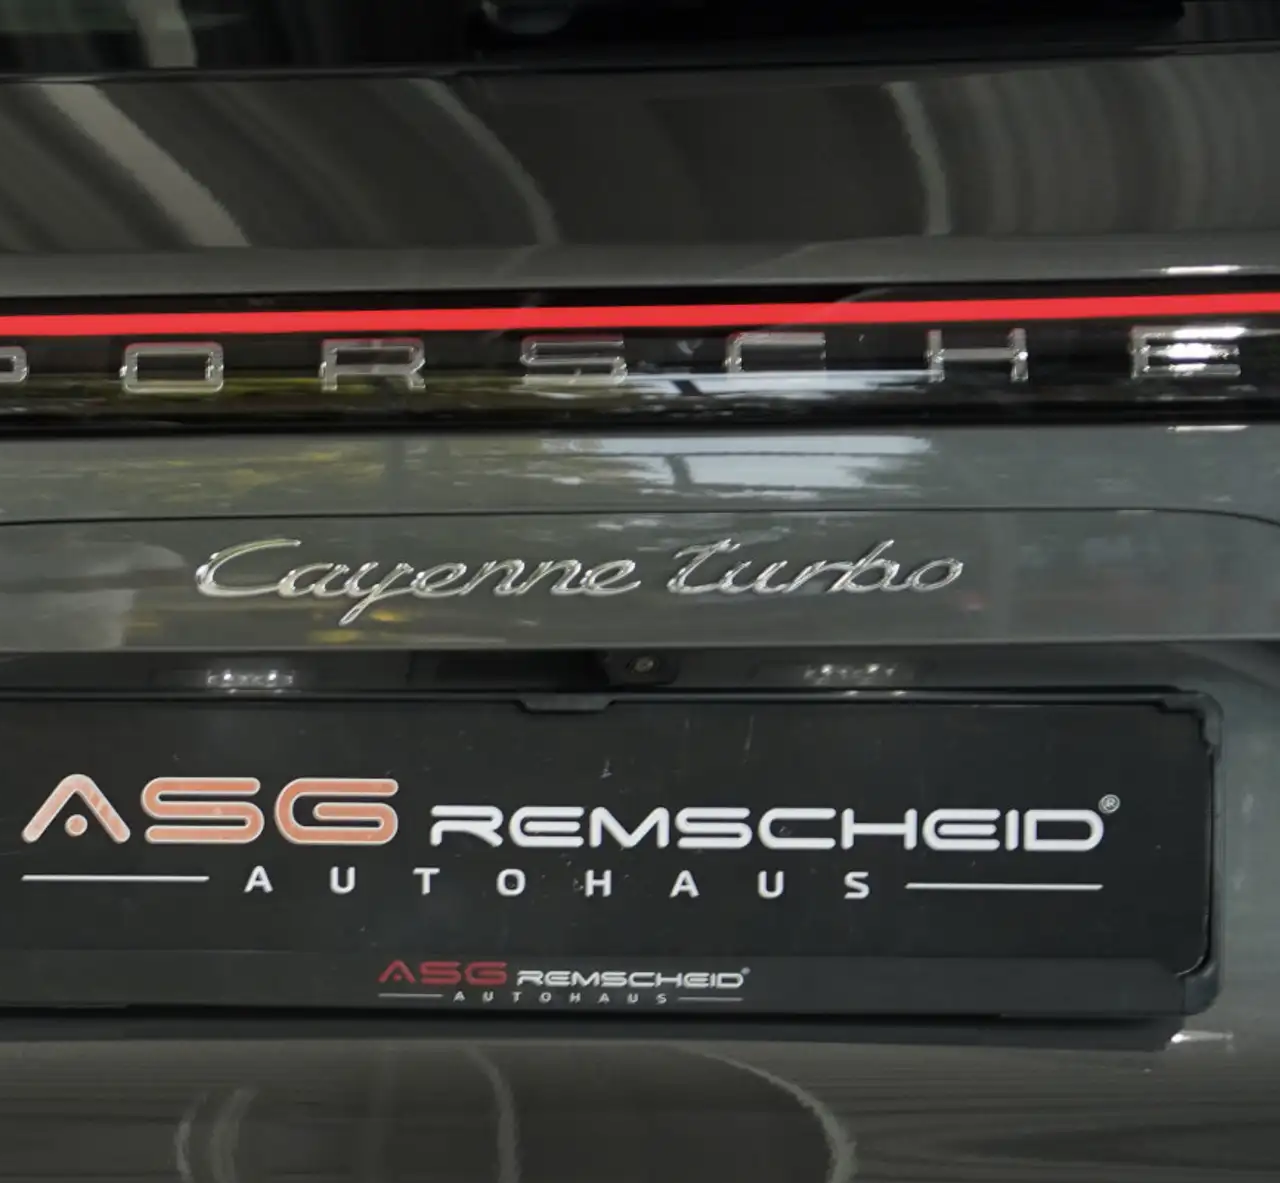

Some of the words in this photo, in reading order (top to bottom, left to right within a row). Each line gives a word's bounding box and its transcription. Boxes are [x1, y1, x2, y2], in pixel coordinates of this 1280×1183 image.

[195, 538, 641, 626] Cayenne
[20, 773, 399, 846] ASG
[244, 866, 870, 901] AUTOHAUS
[377, 959, 508, 986] ASG
[453, 991, 668, 1005] AUTOHAUS
